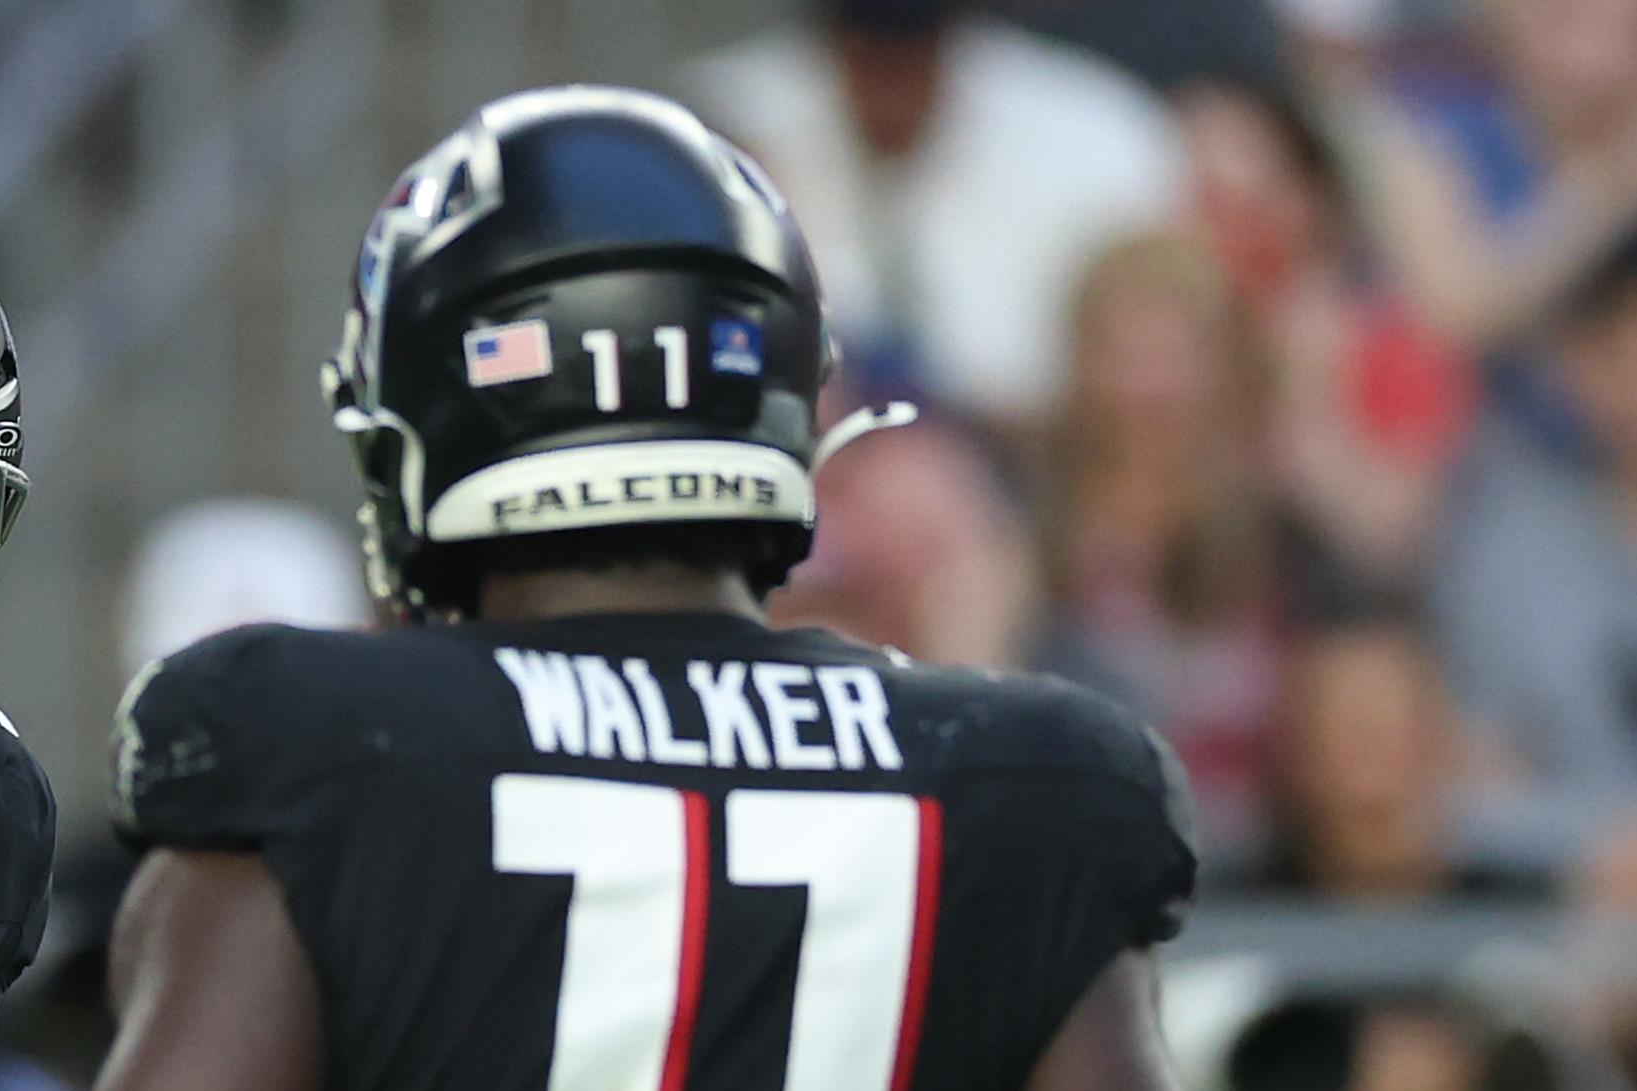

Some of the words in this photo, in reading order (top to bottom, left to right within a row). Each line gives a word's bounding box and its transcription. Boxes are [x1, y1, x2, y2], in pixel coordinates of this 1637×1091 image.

[581, 326, 690, 412] 11
[492, 472, 779, 531] FALCONS
[495, 647, 903, 770] WALKER
